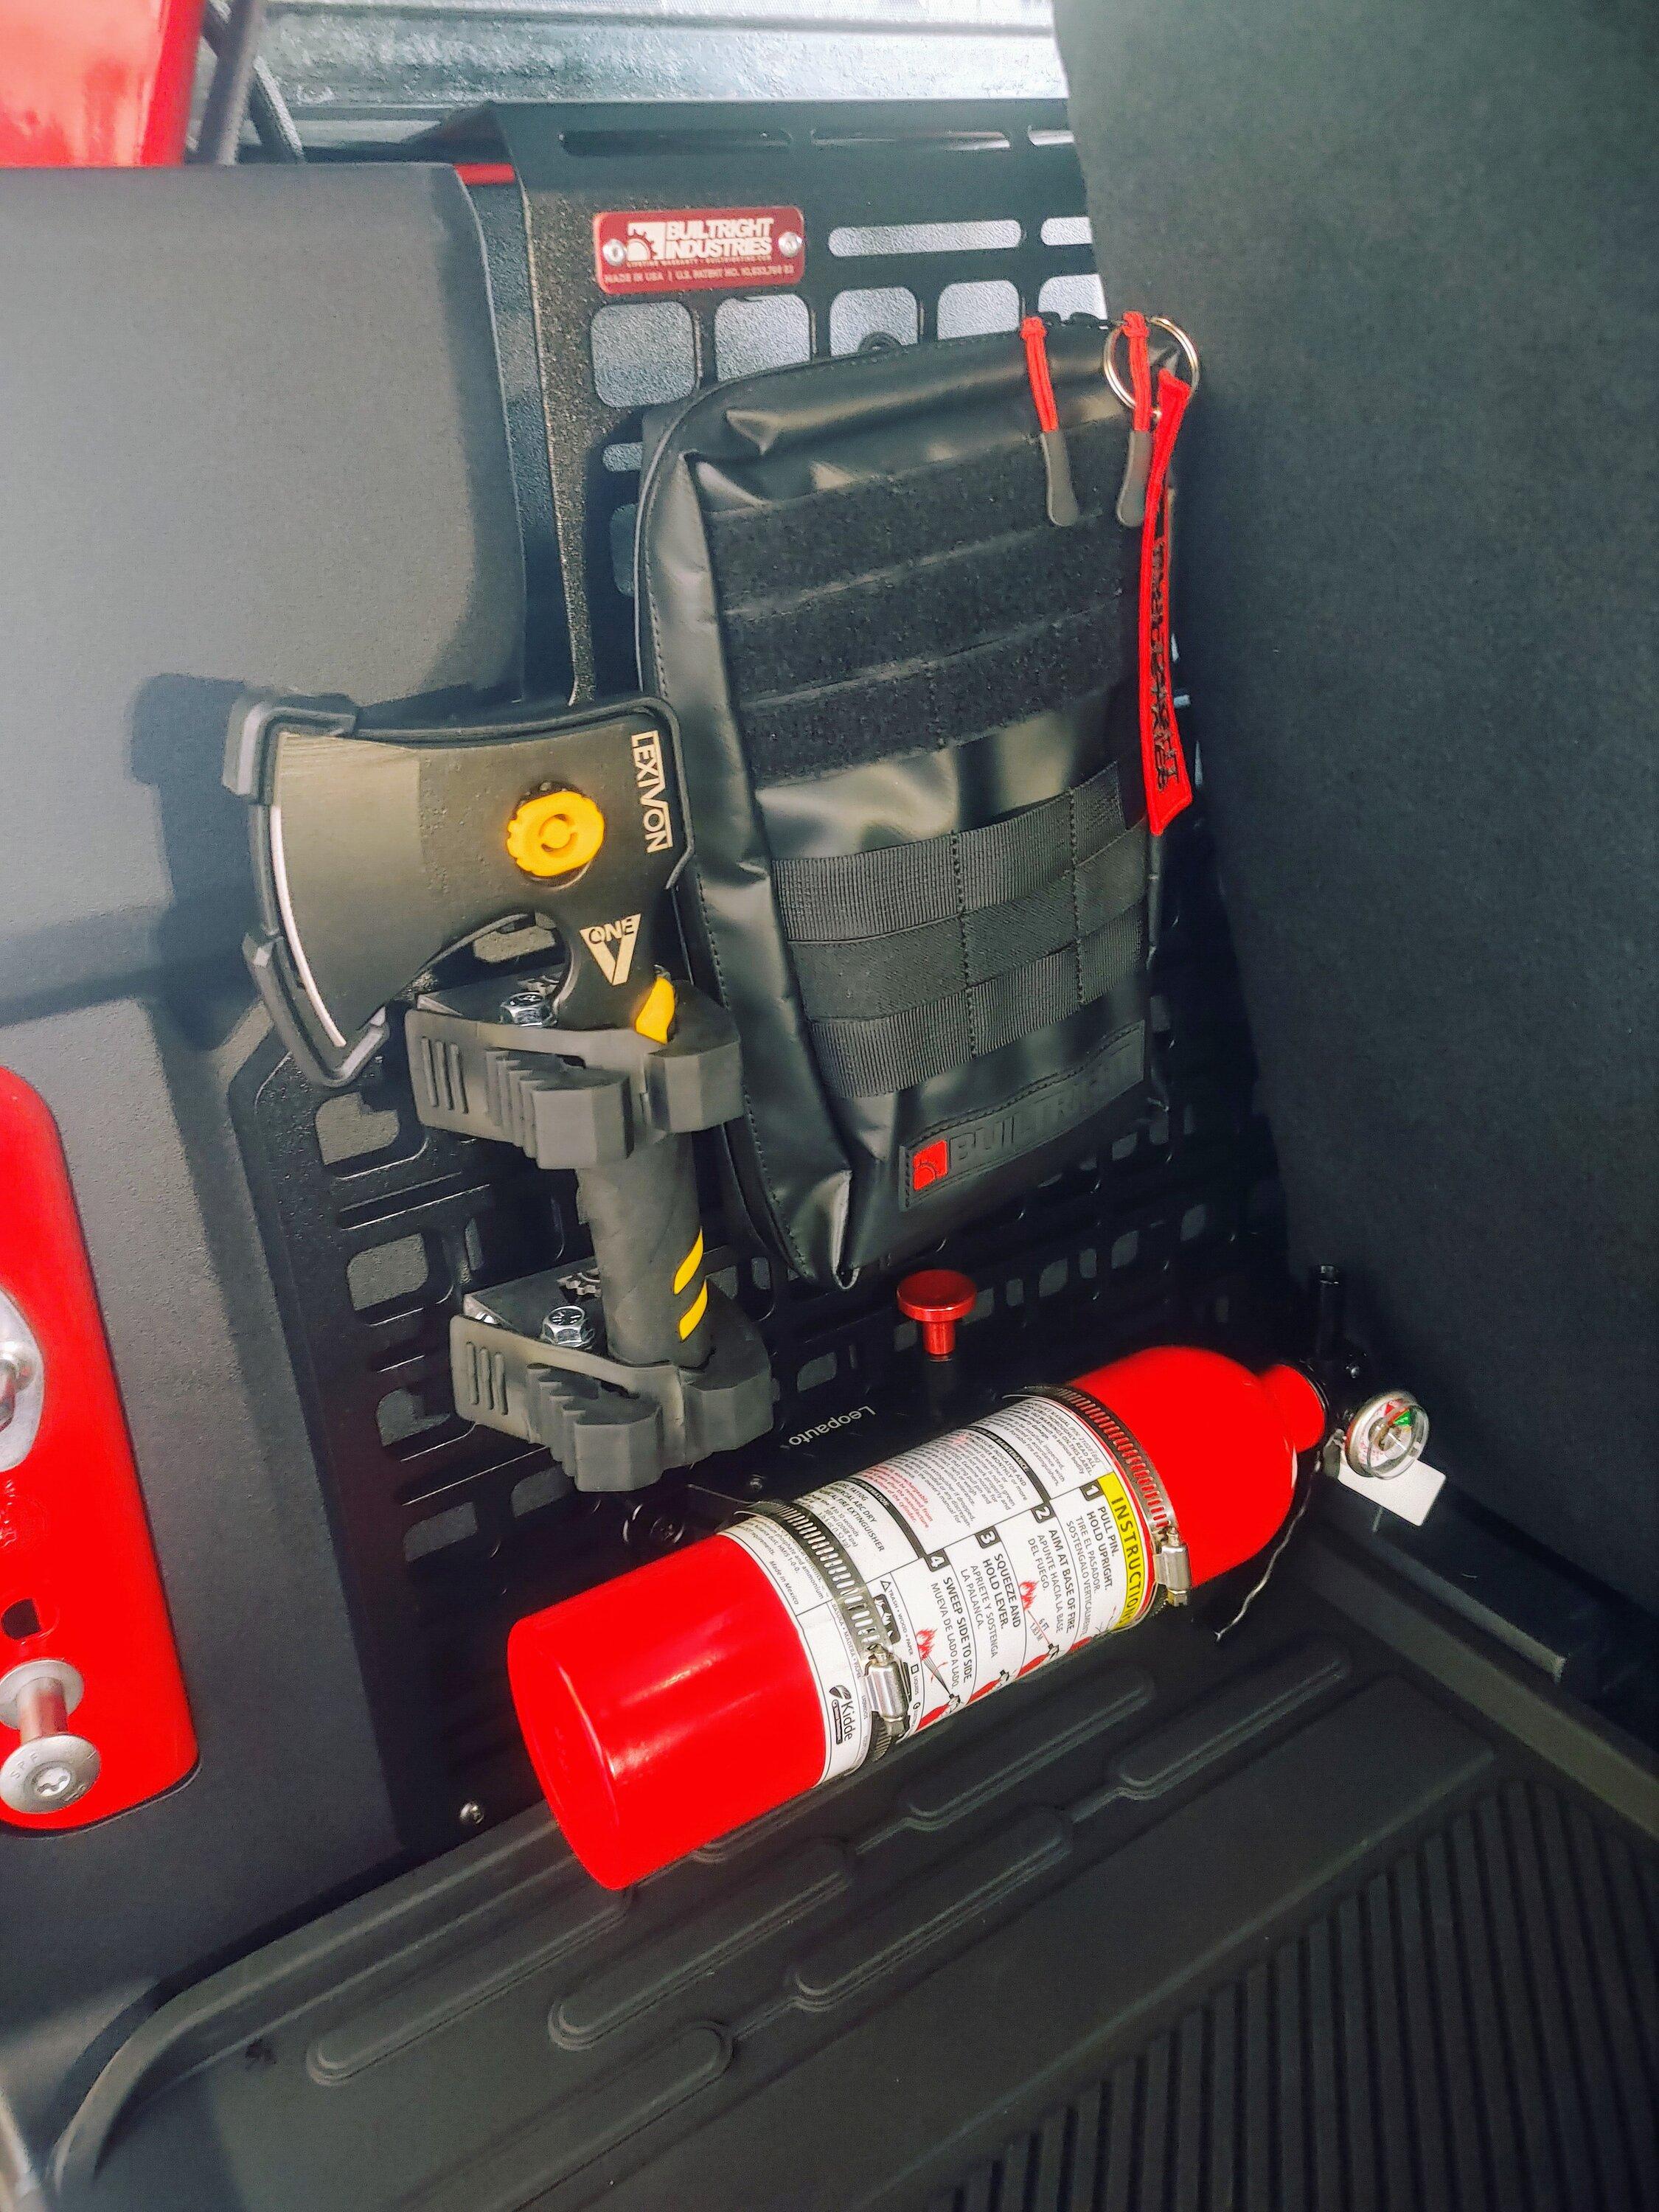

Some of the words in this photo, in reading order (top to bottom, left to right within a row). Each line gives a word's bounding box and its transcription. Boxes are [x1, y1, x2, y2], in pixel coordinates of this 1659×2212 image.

[667, 218, 774, 240] BUILTRIGHT
[666, 237, 772, 258] INDUSTRIES
[631, 730, 673, 854] LEXIVON
[788, 1405, 875, 1447] Leopauto
[1067, 1443, 1081, 1456] THIS
[983, 1457, 1004, 1477] weather
[990, 1454, 1014, 1479] MONTHLY
[1015, 1485, 1029, 1501] more
[992, 1448, 1018, 1473] INDICATOR
[1014, 1472, 1027, 1486] AND
[1053, 1467, 1067, 1482] with
[1068, 1455, 1086, 1475] bodily
[942, 1490, 953, 1501] any
[954, 1481, 977, 1506] tolerance.
[961, 1479, 978, 1496] weigh
[965, 1475, 978, 1486] pull
[973, 1484, 984, 1494] pin
[979, 1492, 992, 1505] and
[973, 1464, 987, 1477] work
[983, 1475, 1004, 1500] properly
[1000, 1499, 1012, 1511] and
[976, 1478, 992, 1494] nozzle
[988, 1493, 999, 1503] for
[1000, 1489, 1017, 1506] green
[1083, 1483, 1100, 1498] 1
[851, 1499, 867, 1512] ABC
[860, 1509, 877, 1523] DRY
[897, 1500, 919, 1523] cylinder.
[901, 1496, 931, 1528] manufacture
[903, 1487, 925, 1509] removed
[919, 1507, 935, 1522] from
[937, 1495, 955, 1513] manual
[951, 1513, 963, 1524] for
[955, 1495, 977, 1522] dropped,
[1034, 1507, 1050, 1521] 2
[841, 1517, 860, 1537] seconds
[846, 1506, 886, 1551] EXTINGUISHER
[979, 1531, 996, 1545] 3
[1075, 1514, 1090, 1537] TIRE
[1097, 1506, 1113, 1533] PULL
[1107, 1534, 1119, 1557] PIN.
[1037, 1532, 1056, 1571] APUNTE
[1048, 1528, 1063, 1552] AIM
[1066, 1520, 1089, 1579] SOSTENGALO
[1083, 1537, 1093, 1550] EL
[1086, 1510, 1104, 1542] HOLD
[1096, 1543, 1113, 1591] UPRIGHT.
[928, 1553, 945, 1568] 4
[1027, 1537, 1040, 1557] DEL
[1034, 1557, 1050, 1592] FUEGO.
[1057, 1551, 1068, 1567] AT
[1087, 1549, 1102, 1594] PASADOR.
[767, 1559, 782, 1576] Made
[783, 1582, 801, 1604] Mexico
[793, 1554, 805, 1566] and
[800, 1565, 825, 1599] ammonium
[970, 1563, 990, 1604] APRIETE
[1048, 1571, 1062, 1600] HACIA
[1061, 1568, 1074, 1597] BASE
[930, 1582, 949, 1618] MUEVA
[943, 1576, 963, 1615] SWEEP
[959, 1568, 971, 1582] LA
[965, 1582, 985, 1630] PALANCA.
[982, 1558, 1001, 1590] HOLD
[993, 1591, 1009, 1630] LEVER.
[993, 1552, 1017, 1603] SQUEEZE
[1009, 1604, 1021, 1629] AND
[1066, 1596, 1076, 1611] OF
[983, 1601, 992, 1610] Y
[1054, 1599, 1064, 1613] LA
[887, 1588, 899, 1609] TRASH
[897, 1612, 908, 1634] WOOD
[905, 1638, 914, 1656] PAPER
[942, 1617, 953, 1632] DE
[956, 1616, 970, 1644] SIDE
[984, 1610, 998, 1658] SOSTENGA
[1040, 1622, 1049, 1631] FT
[1055, 1613, 1063, 1634] BASE
[843, 1630, 855, 1658] MADERA
[946, 1632, 957, 1658] LADO
[961, 1642, 972, 1659] TO
[950, 1658, 958, 1666] A
[839, 1700, 857, 1742] Kidde
